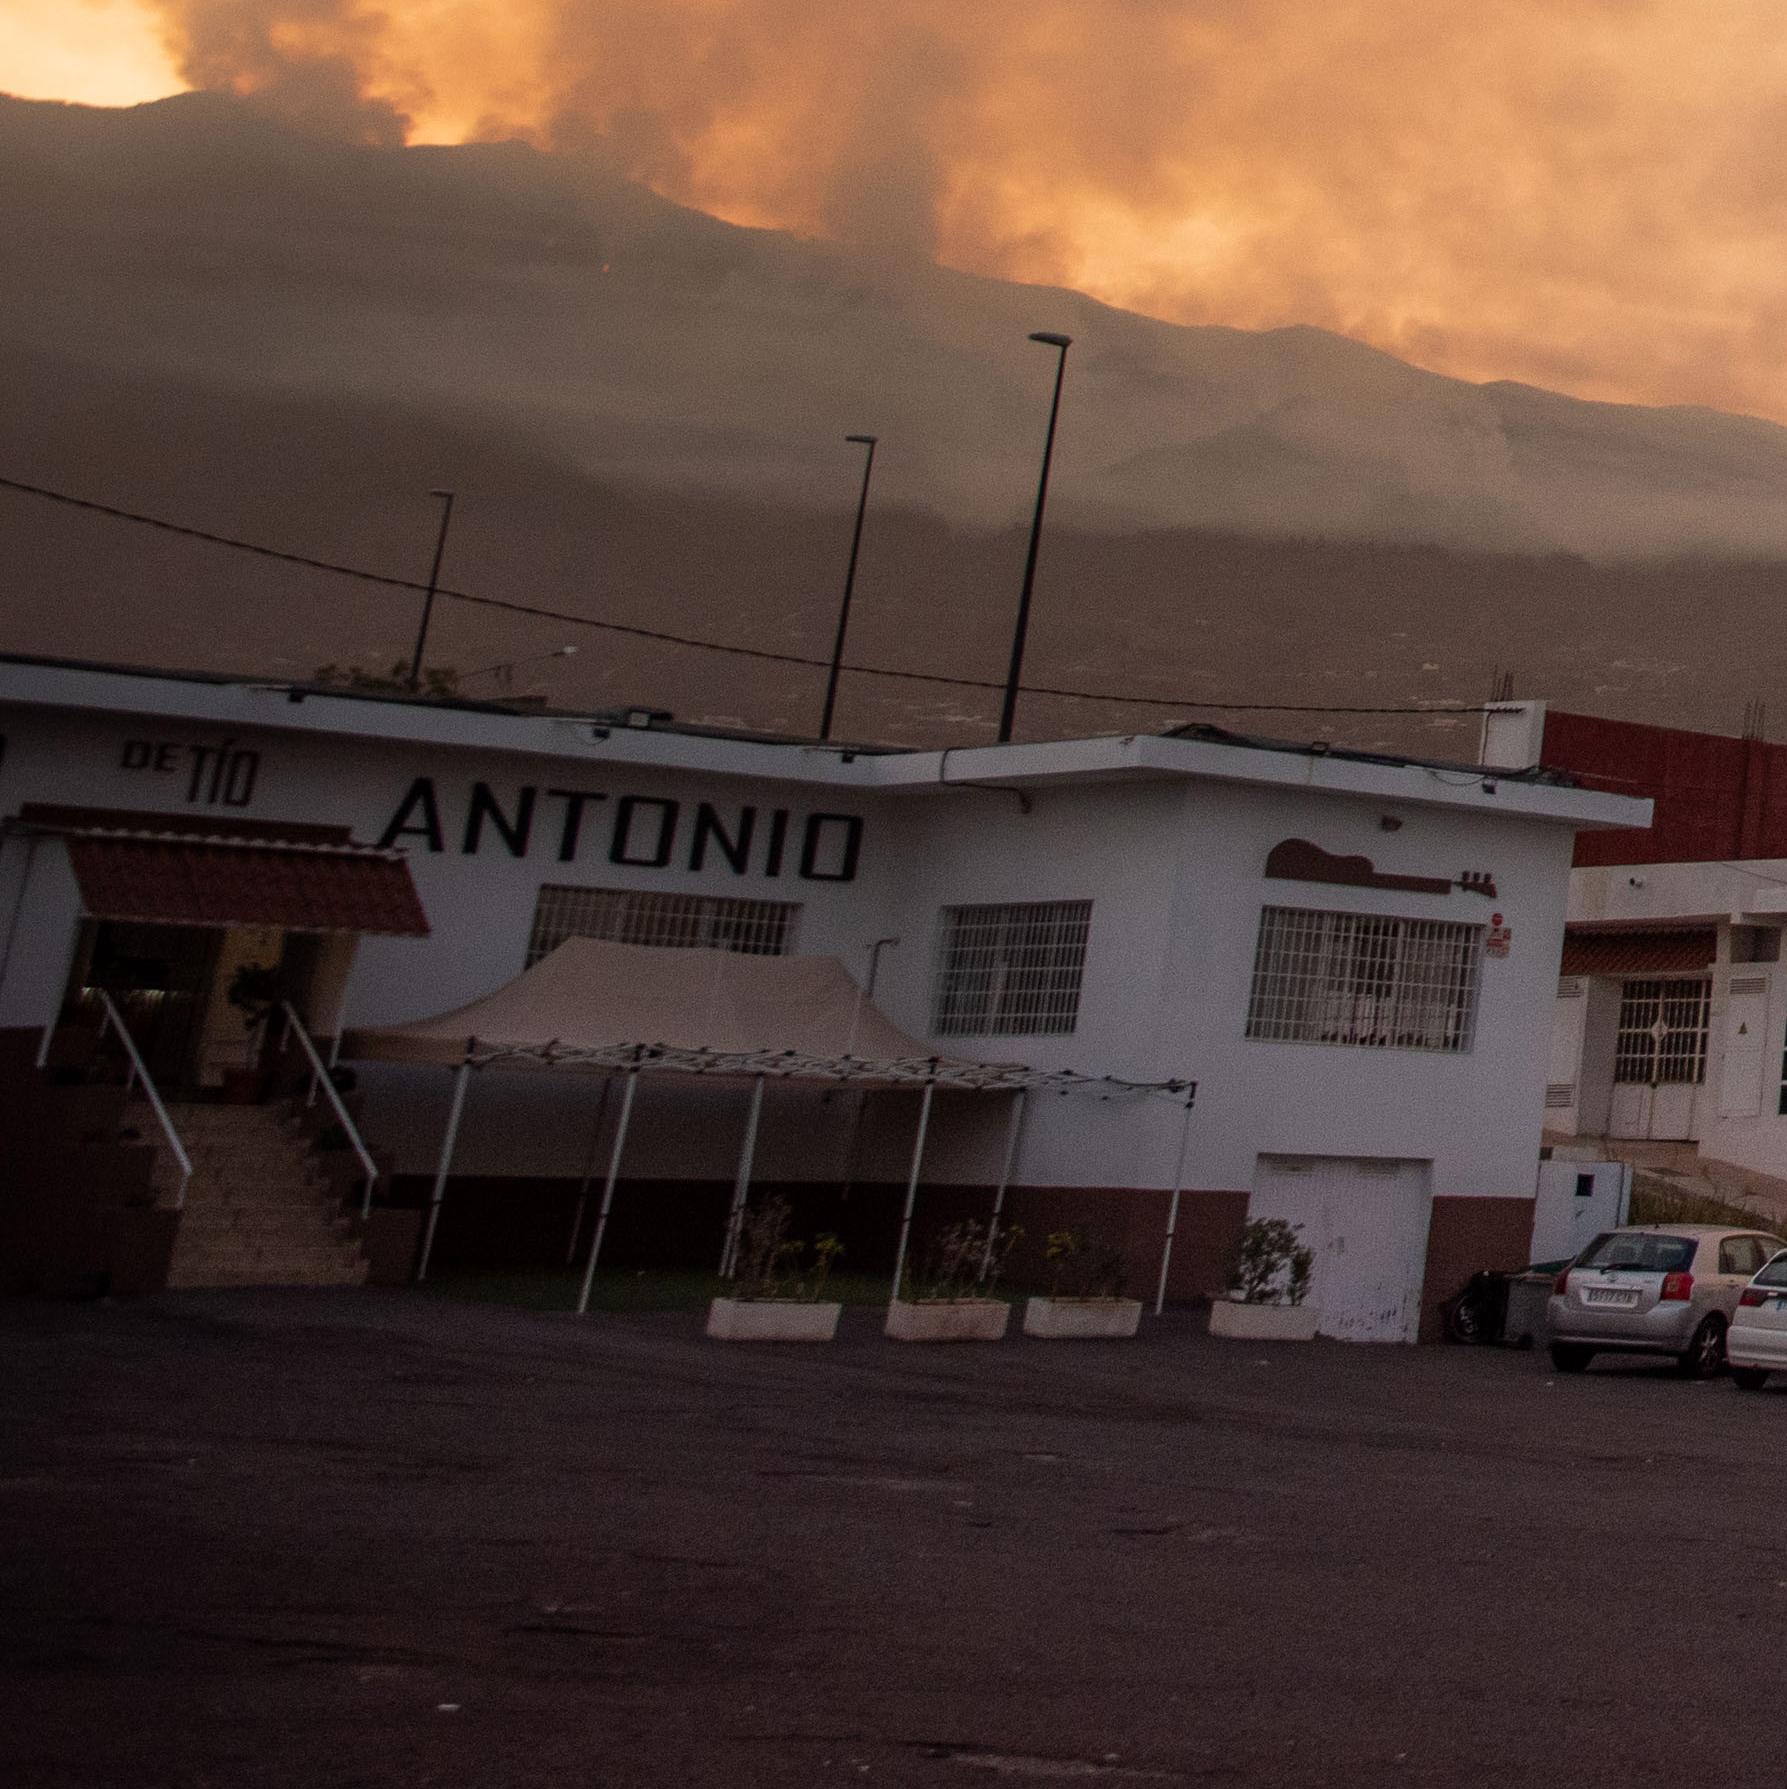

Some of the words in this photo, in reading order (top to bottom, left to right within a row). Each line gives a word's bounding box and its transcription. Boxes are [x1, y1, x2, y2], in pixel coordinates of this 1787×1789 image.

[120, 739, 181, 773] DE
[186, 737, 260, 807] TÍO
[376, 777, 864, 882] ANTONIO
